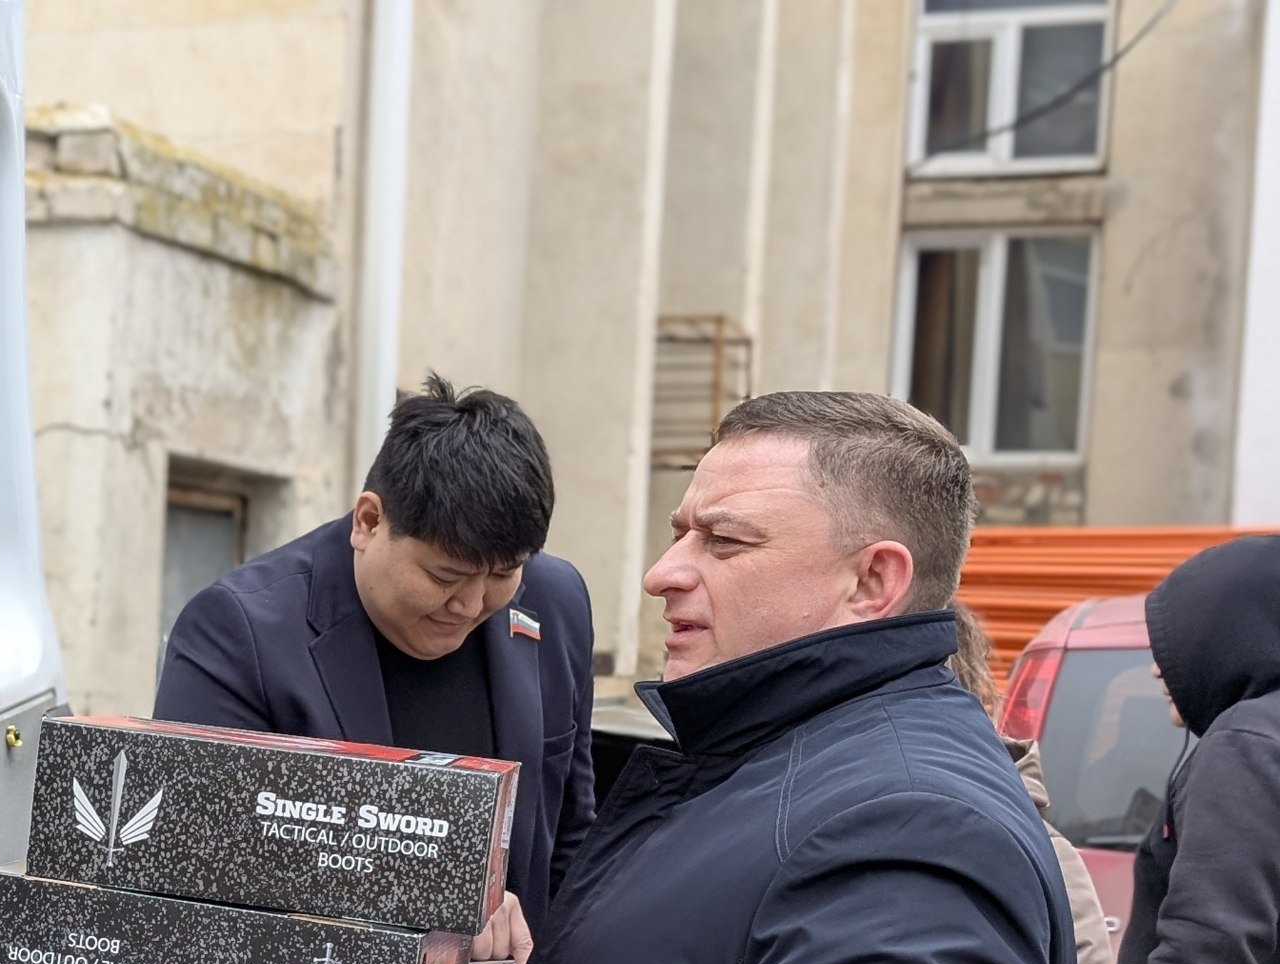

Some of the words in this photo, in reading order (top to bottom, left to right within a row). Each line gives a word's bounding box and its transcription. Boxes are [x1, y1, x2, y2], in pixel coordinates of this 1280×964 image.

[256, 791, 346, 825] SINGLE
[357, 804, 449, 838] SWORD
[261, 821, 337, 846] TACTICAL
[340, 832, 350, 847] /
[352, 833, 439, 858] OUTDOOR
[318, 852, 374, 873] BOOTS
[68, 933, 120, 954] BOOTS
